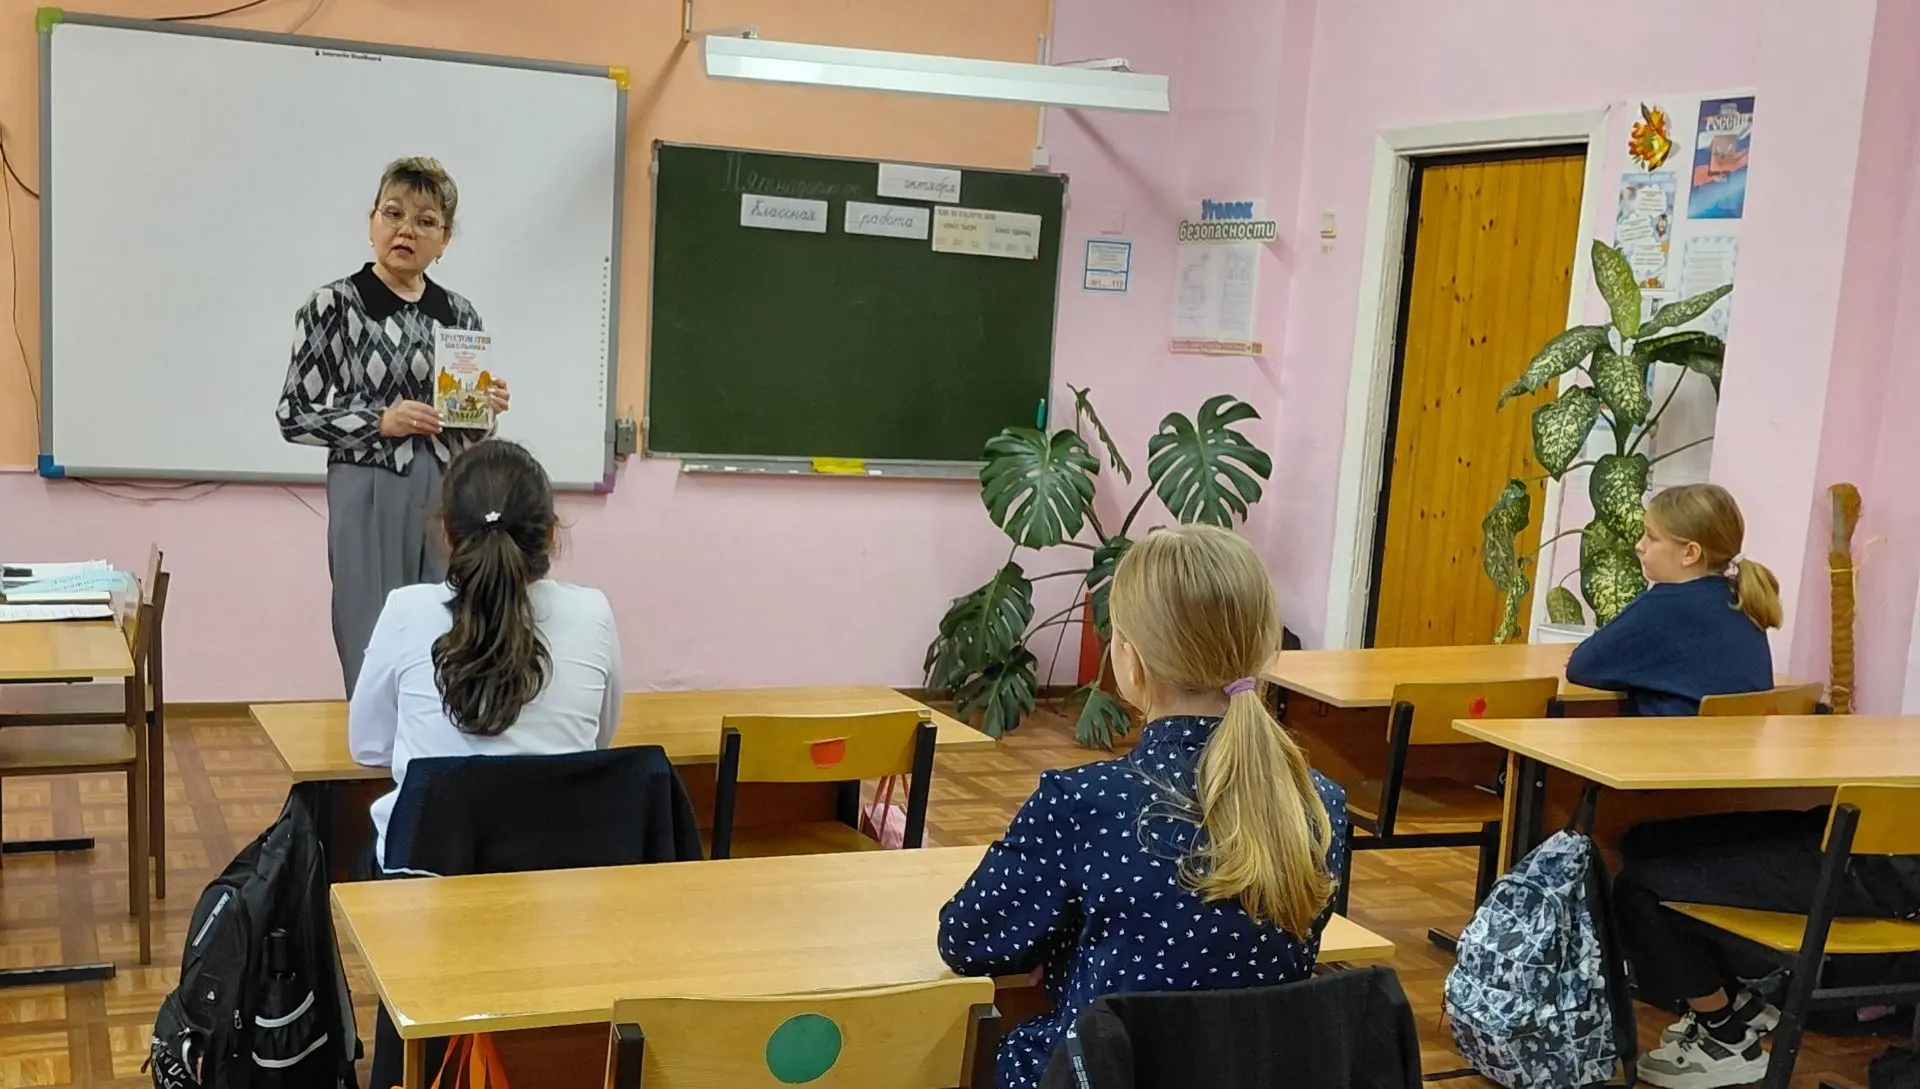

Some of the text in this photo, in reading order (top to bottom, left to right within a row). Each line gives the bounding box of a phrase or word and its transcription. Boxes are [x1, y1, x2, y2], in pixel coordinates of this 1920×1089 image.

[904, 176, 957, 198] октября
[751, 200, 914, 229] Классная работа
[1201, 199, 1253, 220] Уголок
[1179, 220, 1276, 241] безопасности
